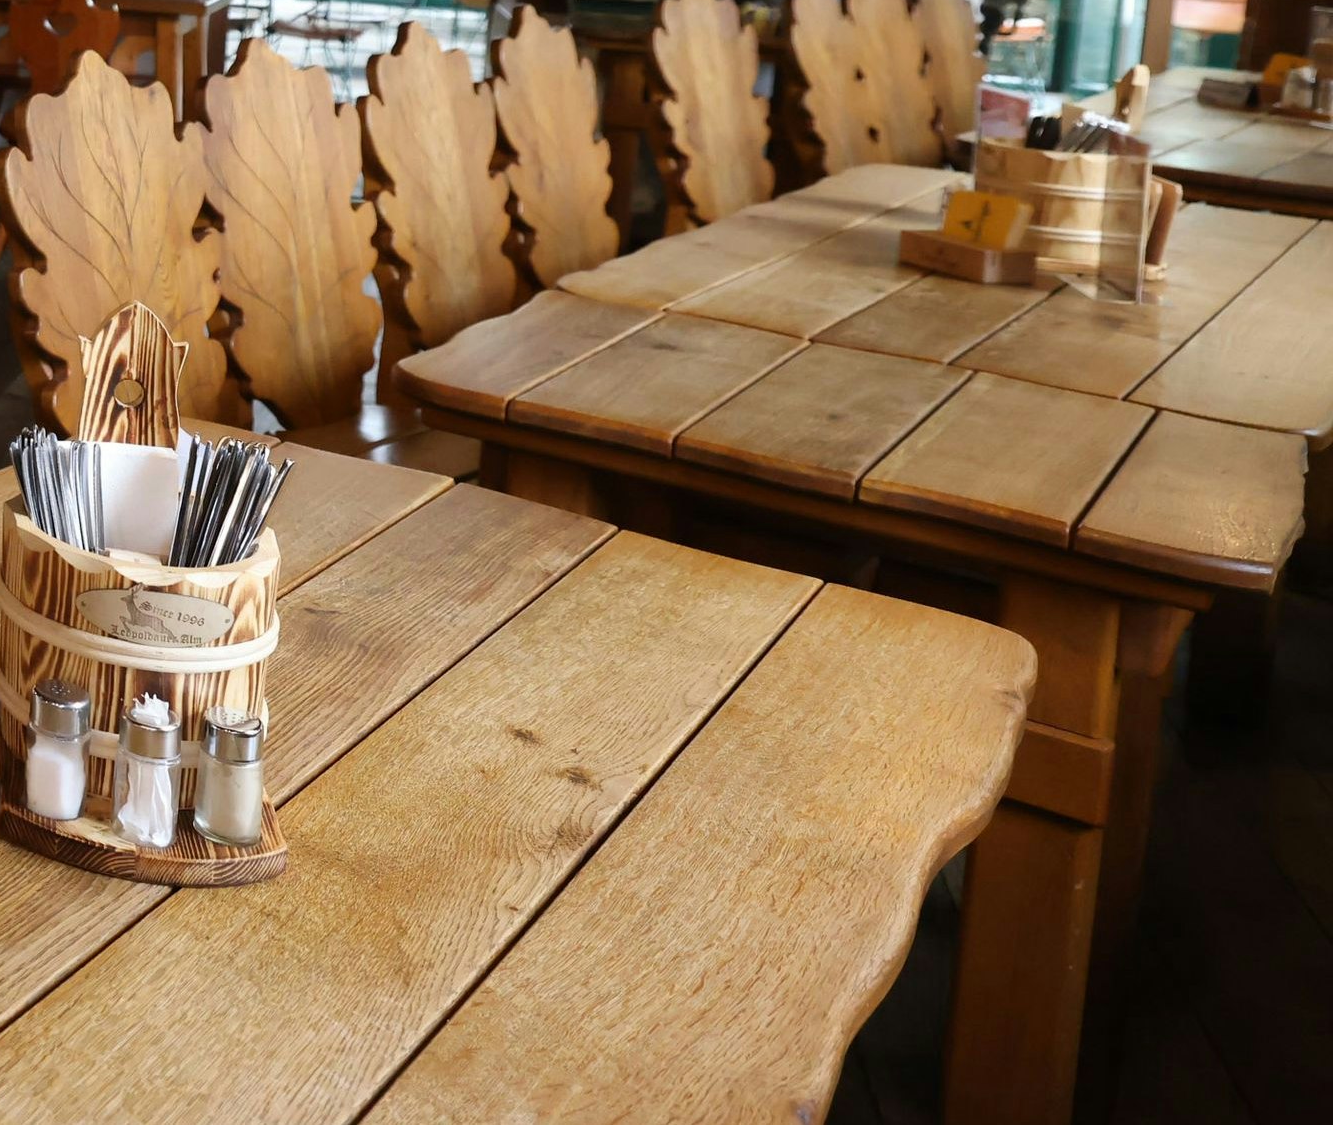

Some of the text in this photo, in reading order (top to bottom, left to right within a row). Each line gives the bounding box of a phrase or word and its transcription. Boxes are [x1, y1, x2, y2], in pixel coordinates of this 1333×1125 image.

[140, 600, 206, 627] Since 1996
[180, 633, 203, 645] Alm
